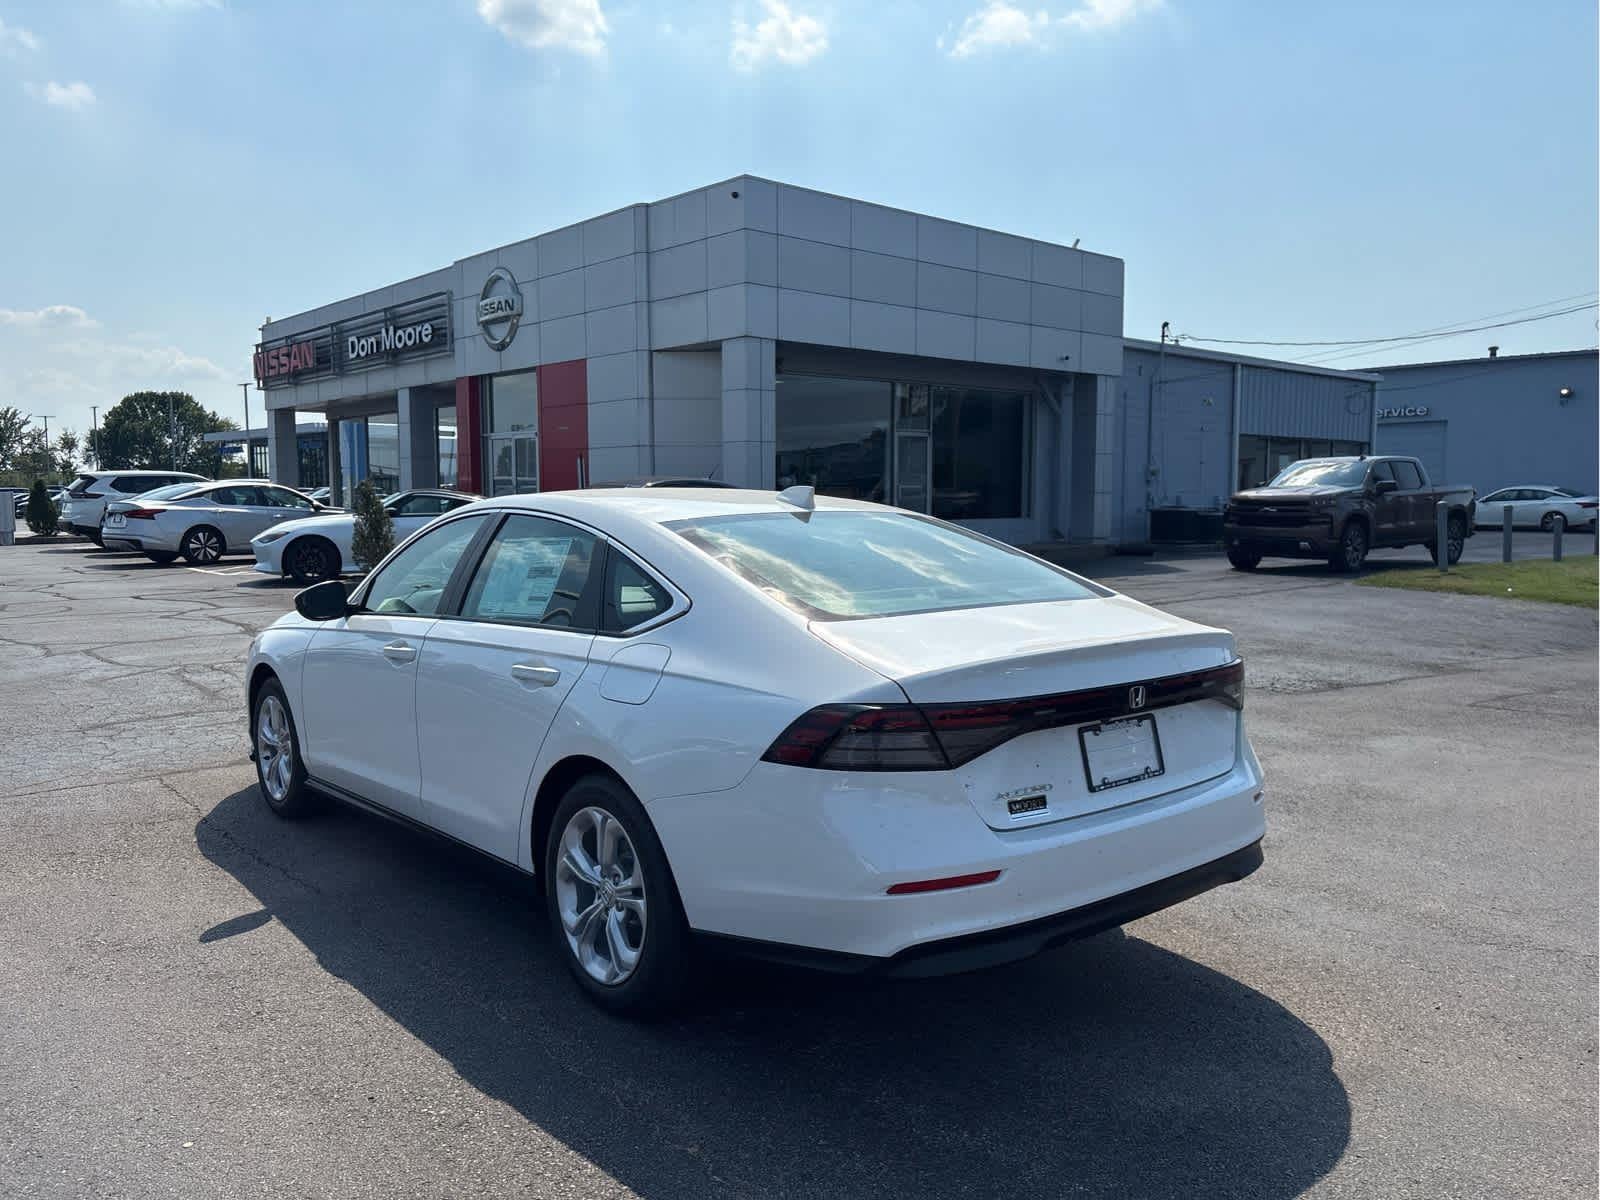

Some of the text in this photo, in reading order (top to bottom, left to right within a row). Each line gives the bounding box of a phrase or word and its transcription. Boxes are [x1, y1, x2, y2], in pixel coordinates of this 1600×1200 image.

[480, 299, 514, 316] ISSAN
[348, 322, 432, 359] Don Moore
[253, 341, 314, 378] NISSAN
[1375, 406, 1428, 417] ervice
